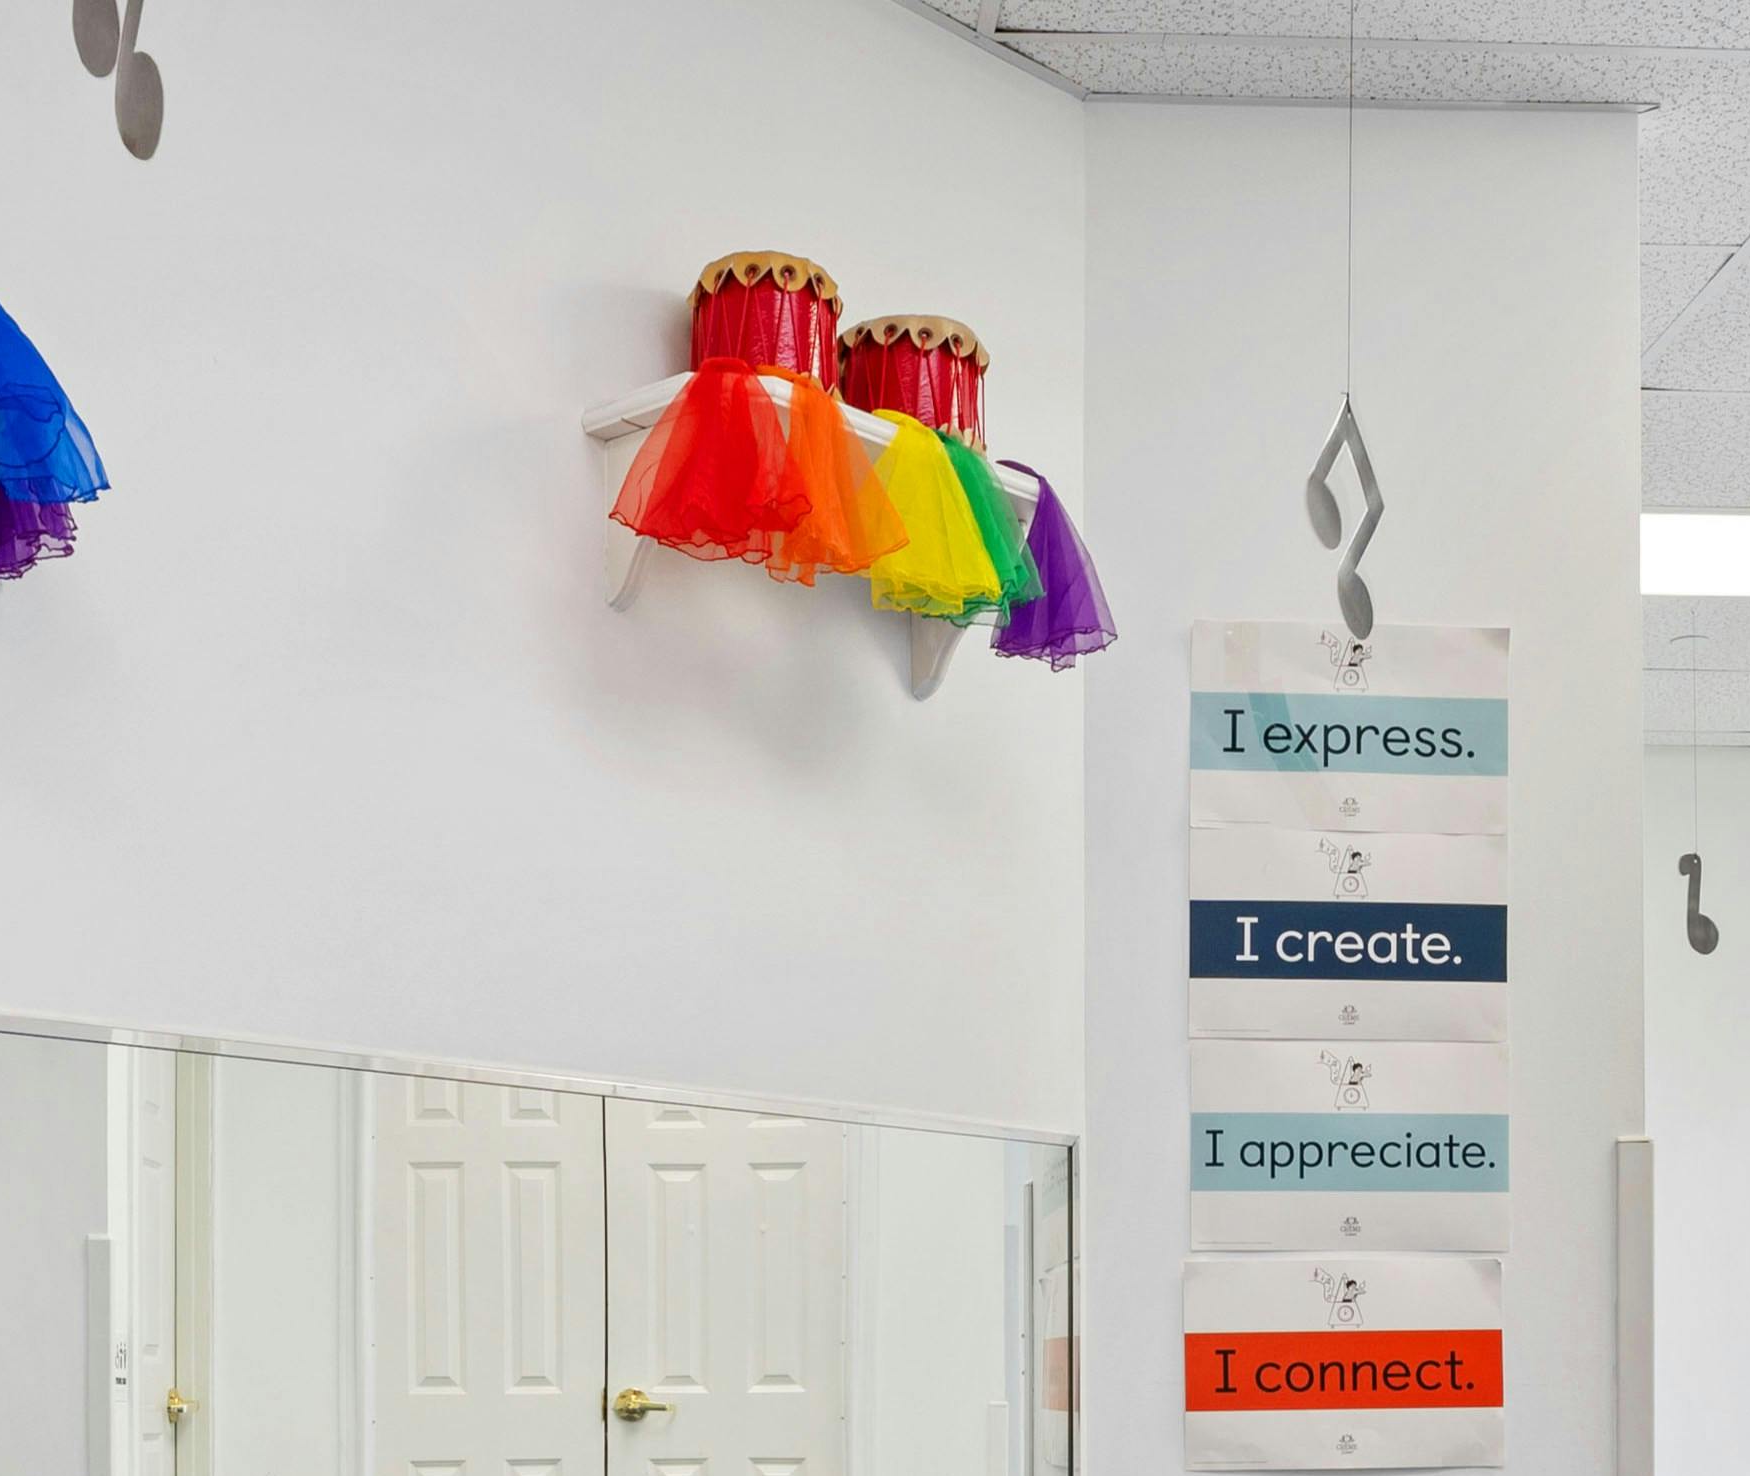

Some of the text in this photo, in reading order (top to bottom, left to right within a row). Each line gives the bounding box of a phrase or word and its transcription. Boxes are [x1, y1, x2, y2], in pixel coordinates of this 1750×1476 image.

[1222, 709, 1475, 767] I express.
[1235, 916, 1462, 965] I create.
[1204, 1129, 1496, 1180] I appreciate.
[1214, 1349, 1475, 1394] I connect.
